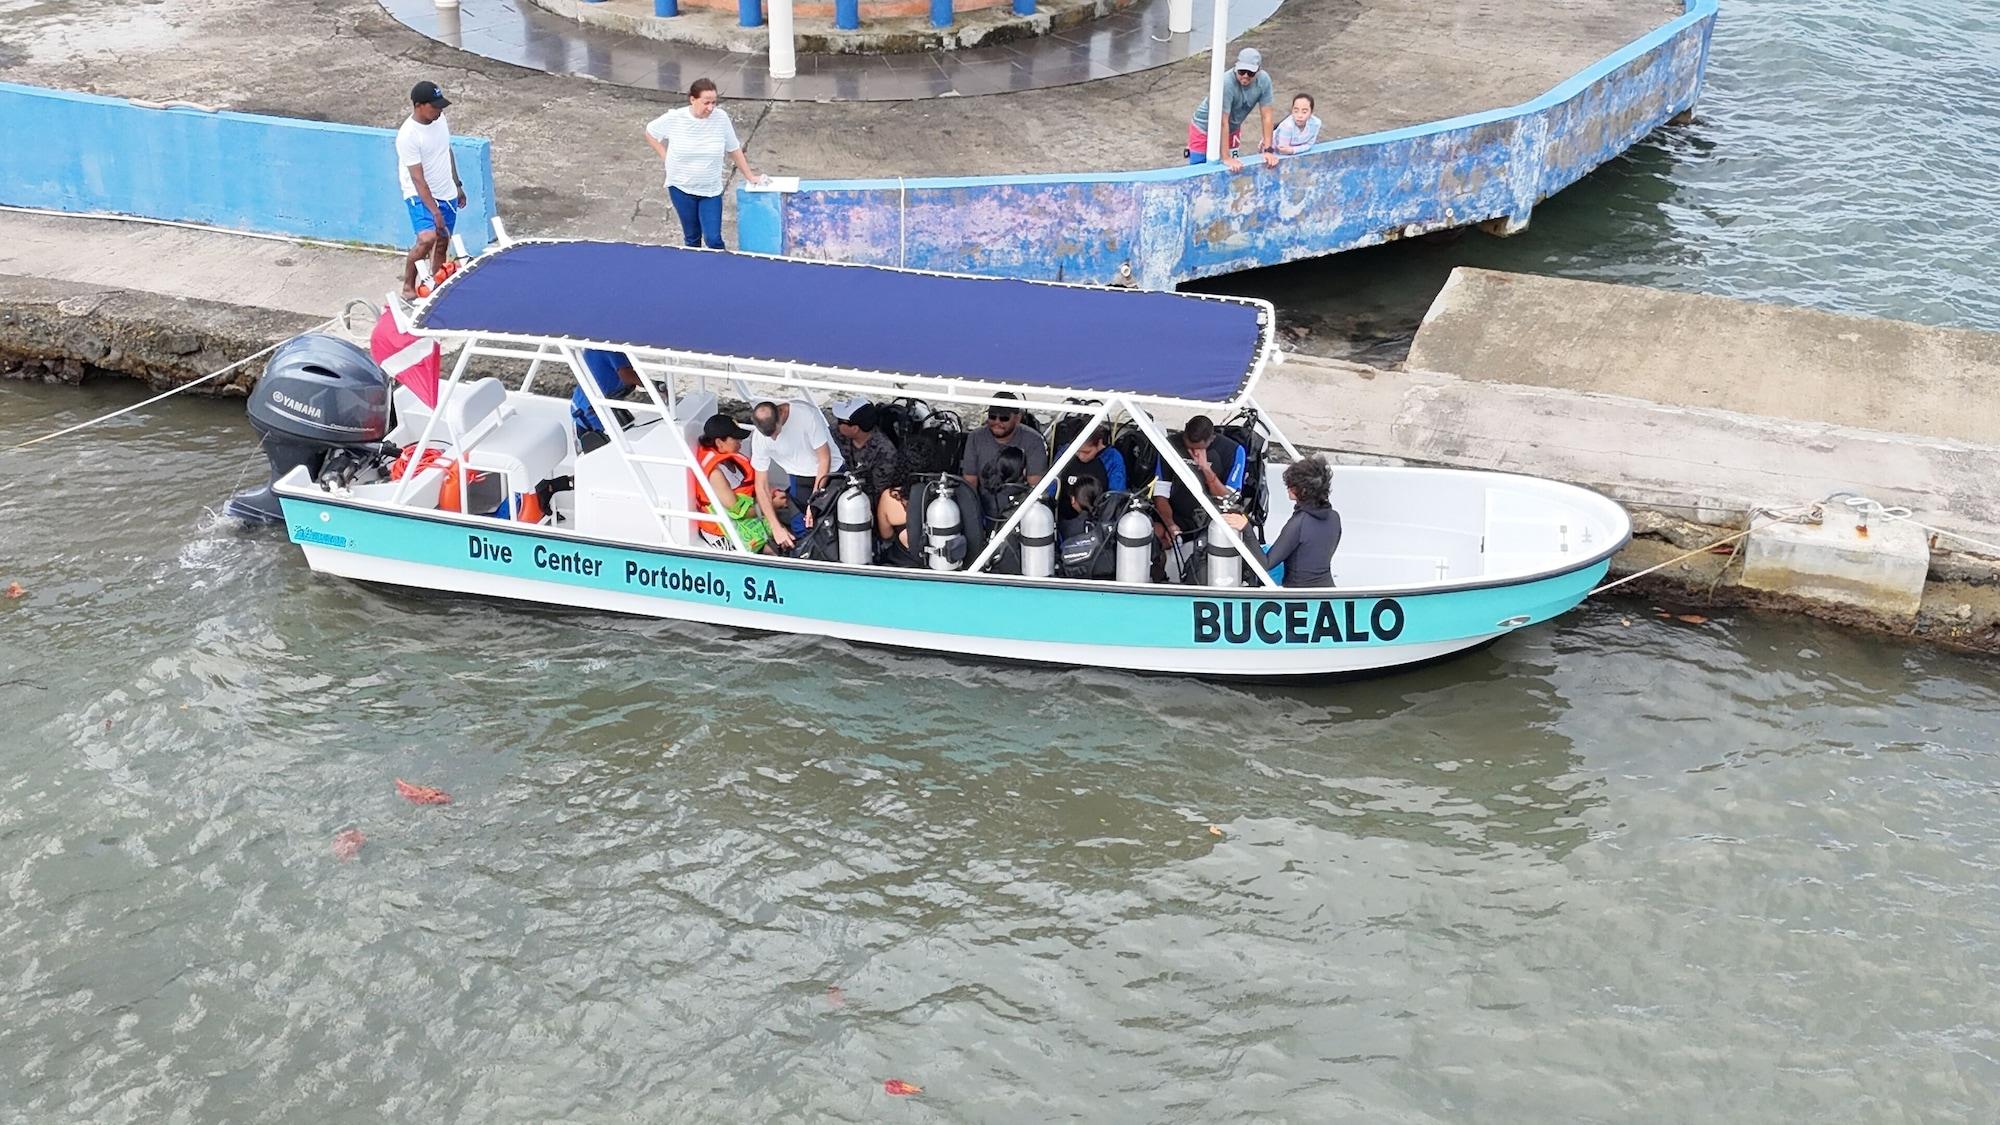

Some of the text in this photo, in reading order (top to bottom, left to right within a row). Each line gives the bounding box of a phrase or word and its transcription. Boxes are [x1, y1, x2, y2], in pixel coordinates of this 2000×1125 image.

[283, 395, 322, 419] YAMAHA
[468, 535, 784, 605] Dive Center Portobelo, S.A.
[1192, 598, 1405, 645] BUCEALO
